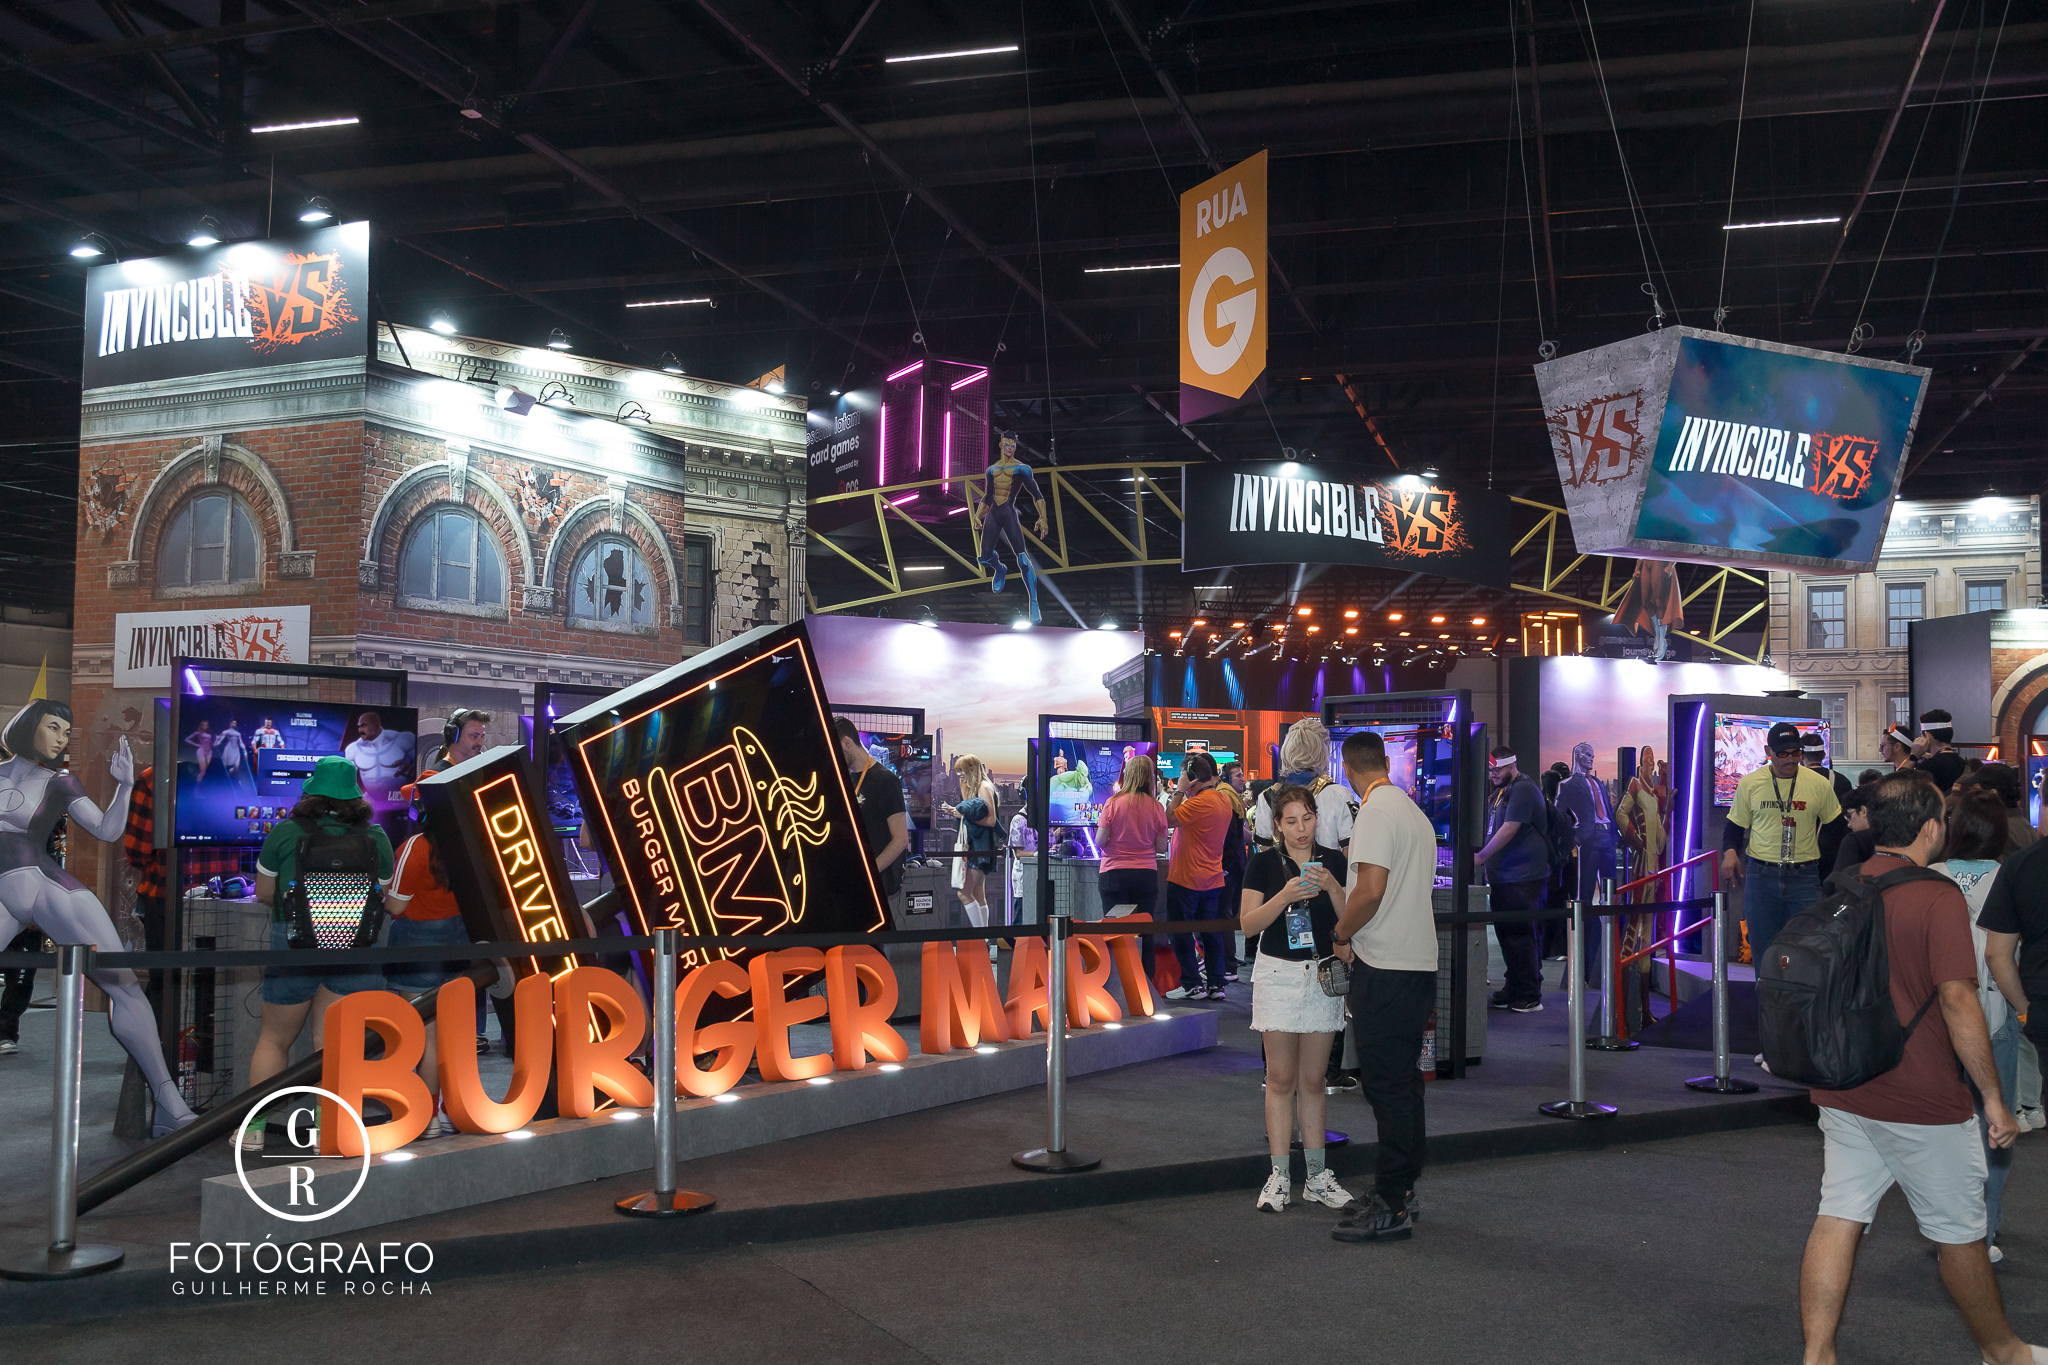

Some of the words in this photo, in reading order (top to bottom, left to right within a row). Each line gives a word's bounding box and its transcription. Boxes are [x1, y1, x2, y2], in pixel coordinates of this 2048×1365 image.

[1196, 181, 1249, 239] RUA
[98, 270, 254, 357] INVINCIBLE
[253, 256, 335, 343] VS
[1187, 246, 1257, 376] G
[810, 443, 830, 467] card
[830, 435, 860, 464] games
[1561, 393, 1641, 487] VS
[1668, 415, 1812, 489] INVINCIBLE
[1814, 434, 1879, 499] VS
[1229, 473, 1385, 544] INVINCIBLE
[1388, 485, 1453, 554] VS
[127, 623, 227, 671] INVINCIBLE
[229, 617, 281, 663] VS
[490, 804, 562, 944] DRIVE
[621, 778, 675, 896] BURGER
[664, 901, 700, 970] MR
[319, 943, 910, 1159] BURGER
[920, 911, 1155, 1055] MART
